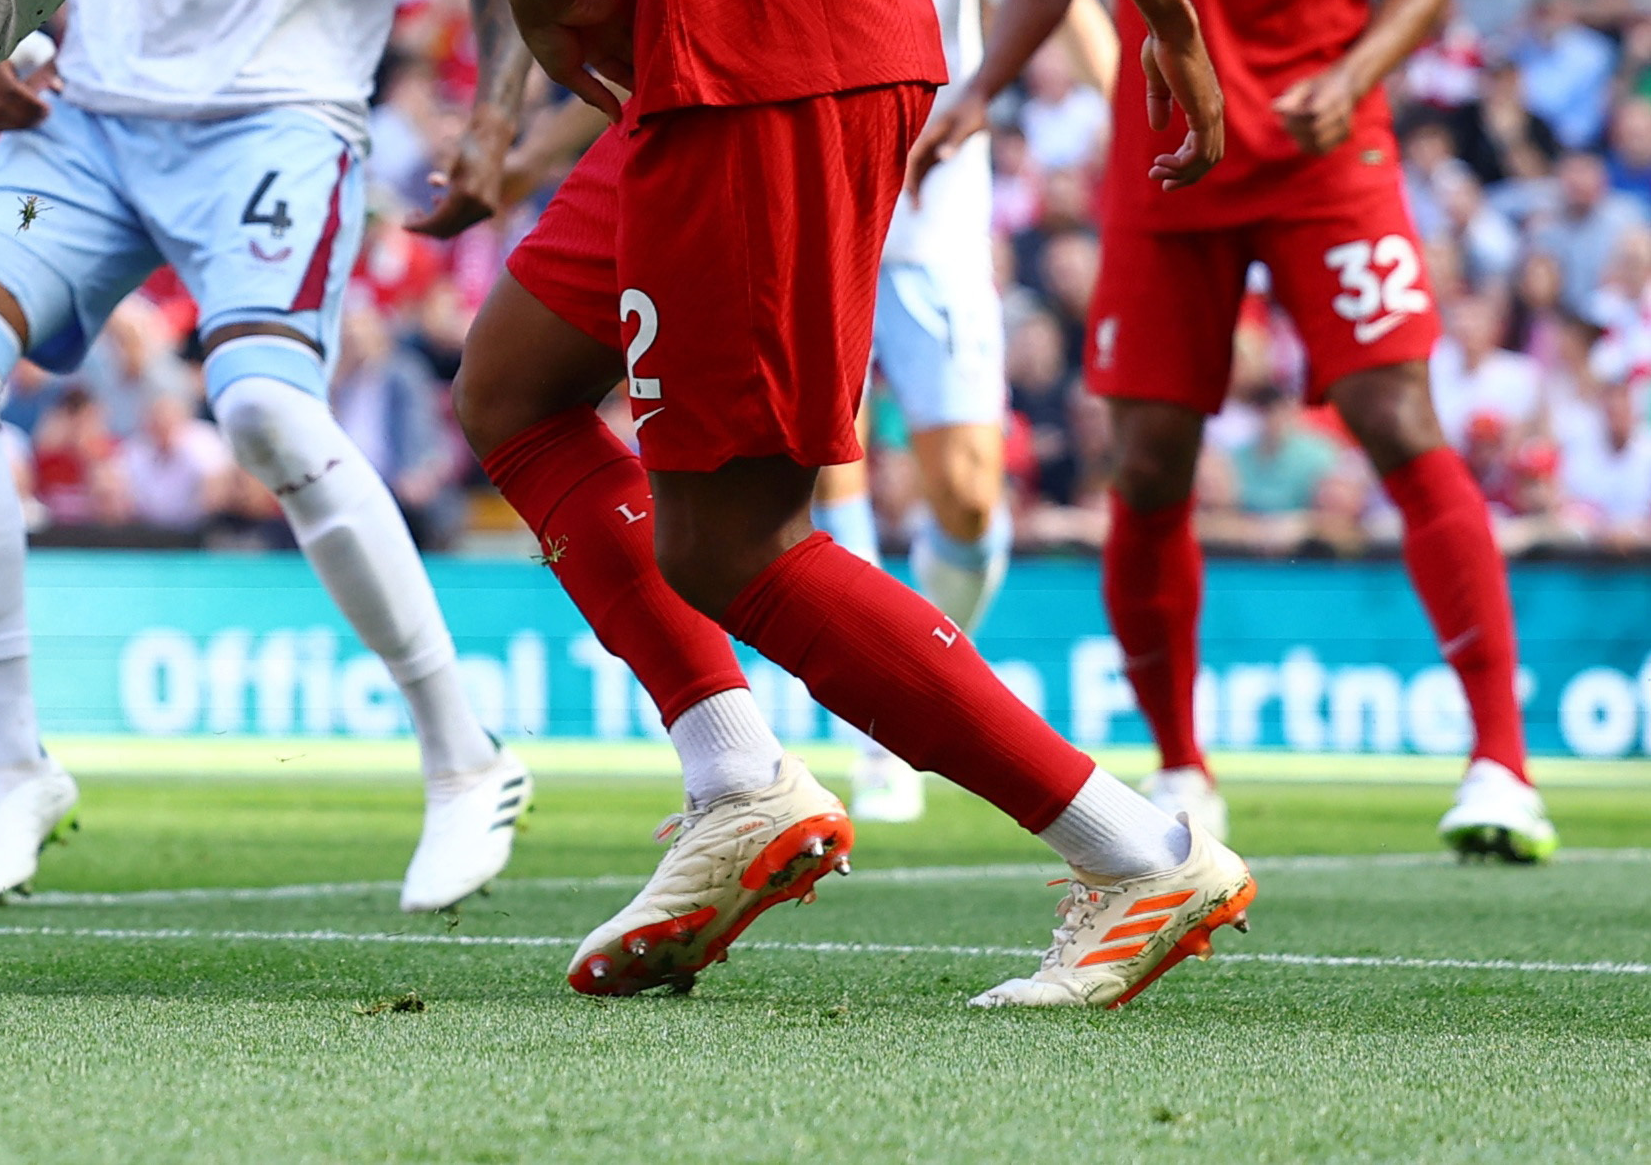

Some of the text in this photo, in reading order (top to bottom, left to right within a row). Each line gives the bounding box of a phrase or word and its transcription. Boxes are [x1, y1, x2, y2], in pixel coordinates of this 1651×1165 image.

[240, 170, 293, 238] 4
[1324, 234, 1430, 322] 32
[619, 288, 662, 399] 2
[116, 625, 546, 737] Offical
[1070, 634, 1540, 753] Prtne
[1557, 650, 1651, 757] o
